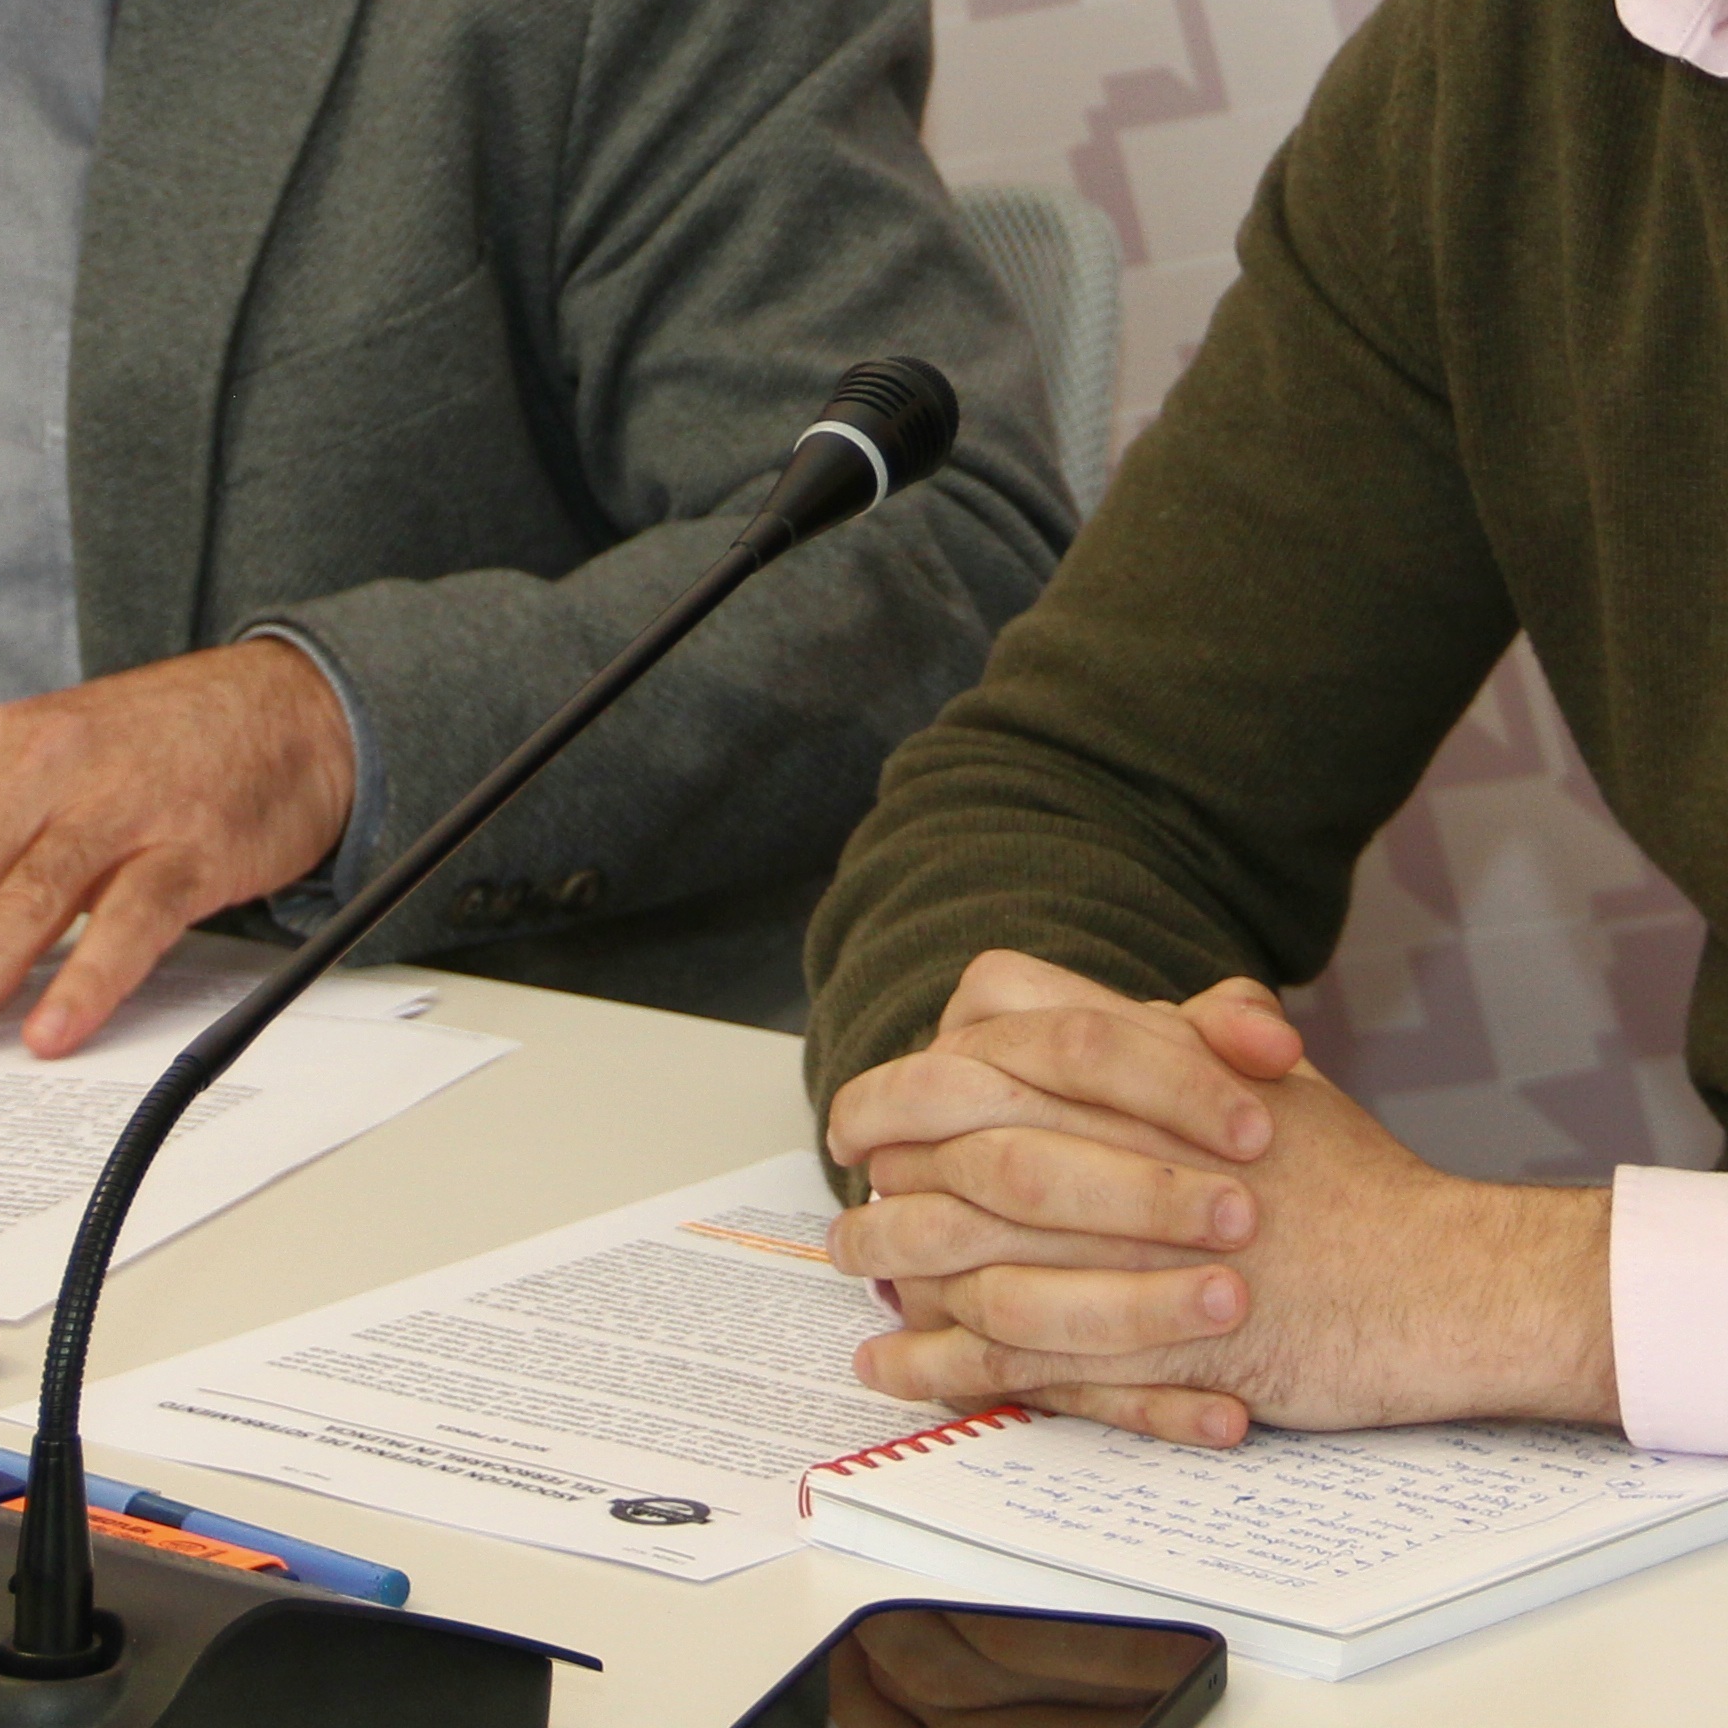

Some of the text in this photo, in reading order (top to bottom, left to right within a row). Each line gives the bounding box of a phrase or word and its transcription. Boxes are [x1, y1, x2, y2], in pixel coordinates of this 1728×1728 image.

[158, 1400, 314, 1438] SOTERRAMIENTO
[324, 1424, 413, 1450] PALENCIA
[352, 1443, 431, 1468] DEFENSA
[446, 1454, 569, 1486] FERROCARRIL
